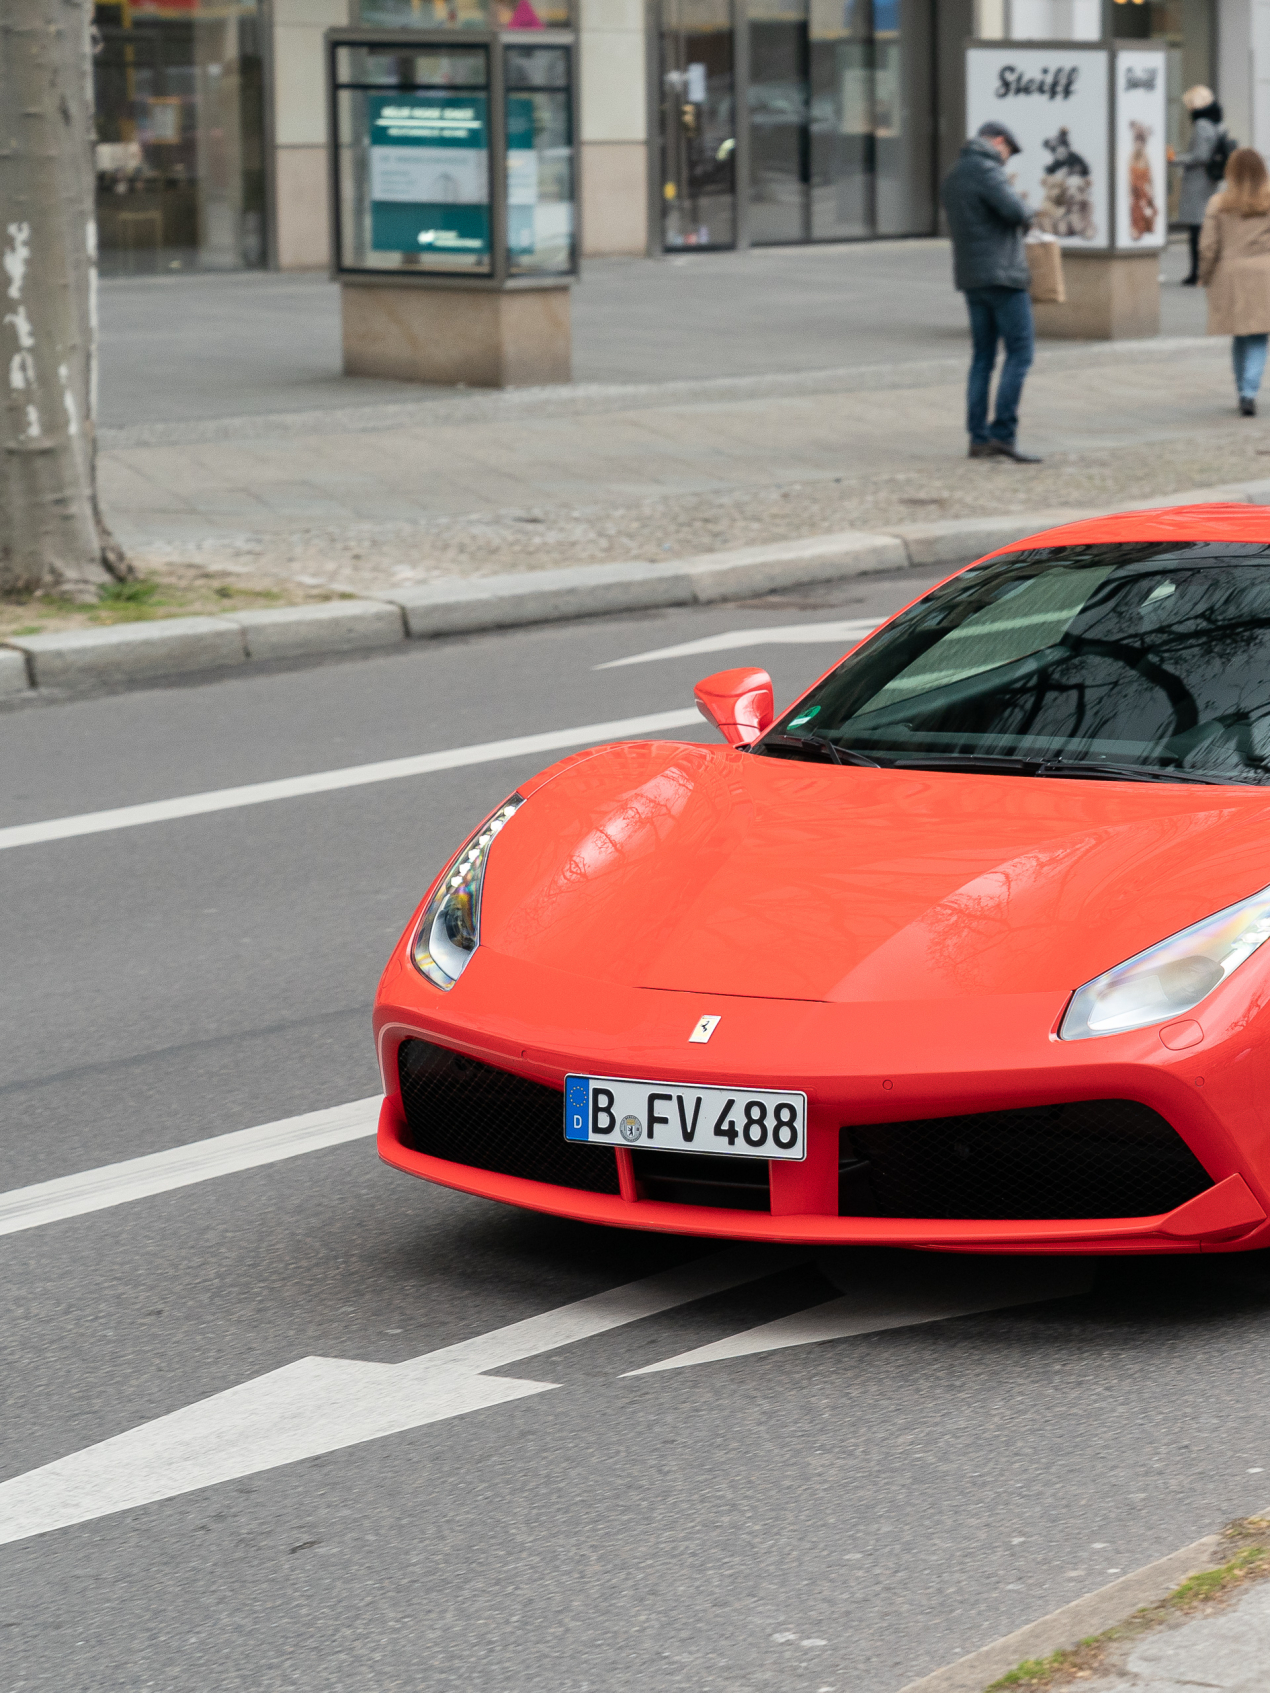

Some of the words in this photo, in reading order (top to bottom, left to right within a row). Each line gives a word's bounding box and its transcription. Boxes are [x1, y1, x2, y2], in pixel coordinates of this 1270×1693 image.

[995, 65, 1079, 100] Steiff
[573, 1114, 582, 1129] D
[592, 1087, 617, 1135] B
[646, 1092, 703, 1143] FV
[713, 1098, 798, 1150] 488
